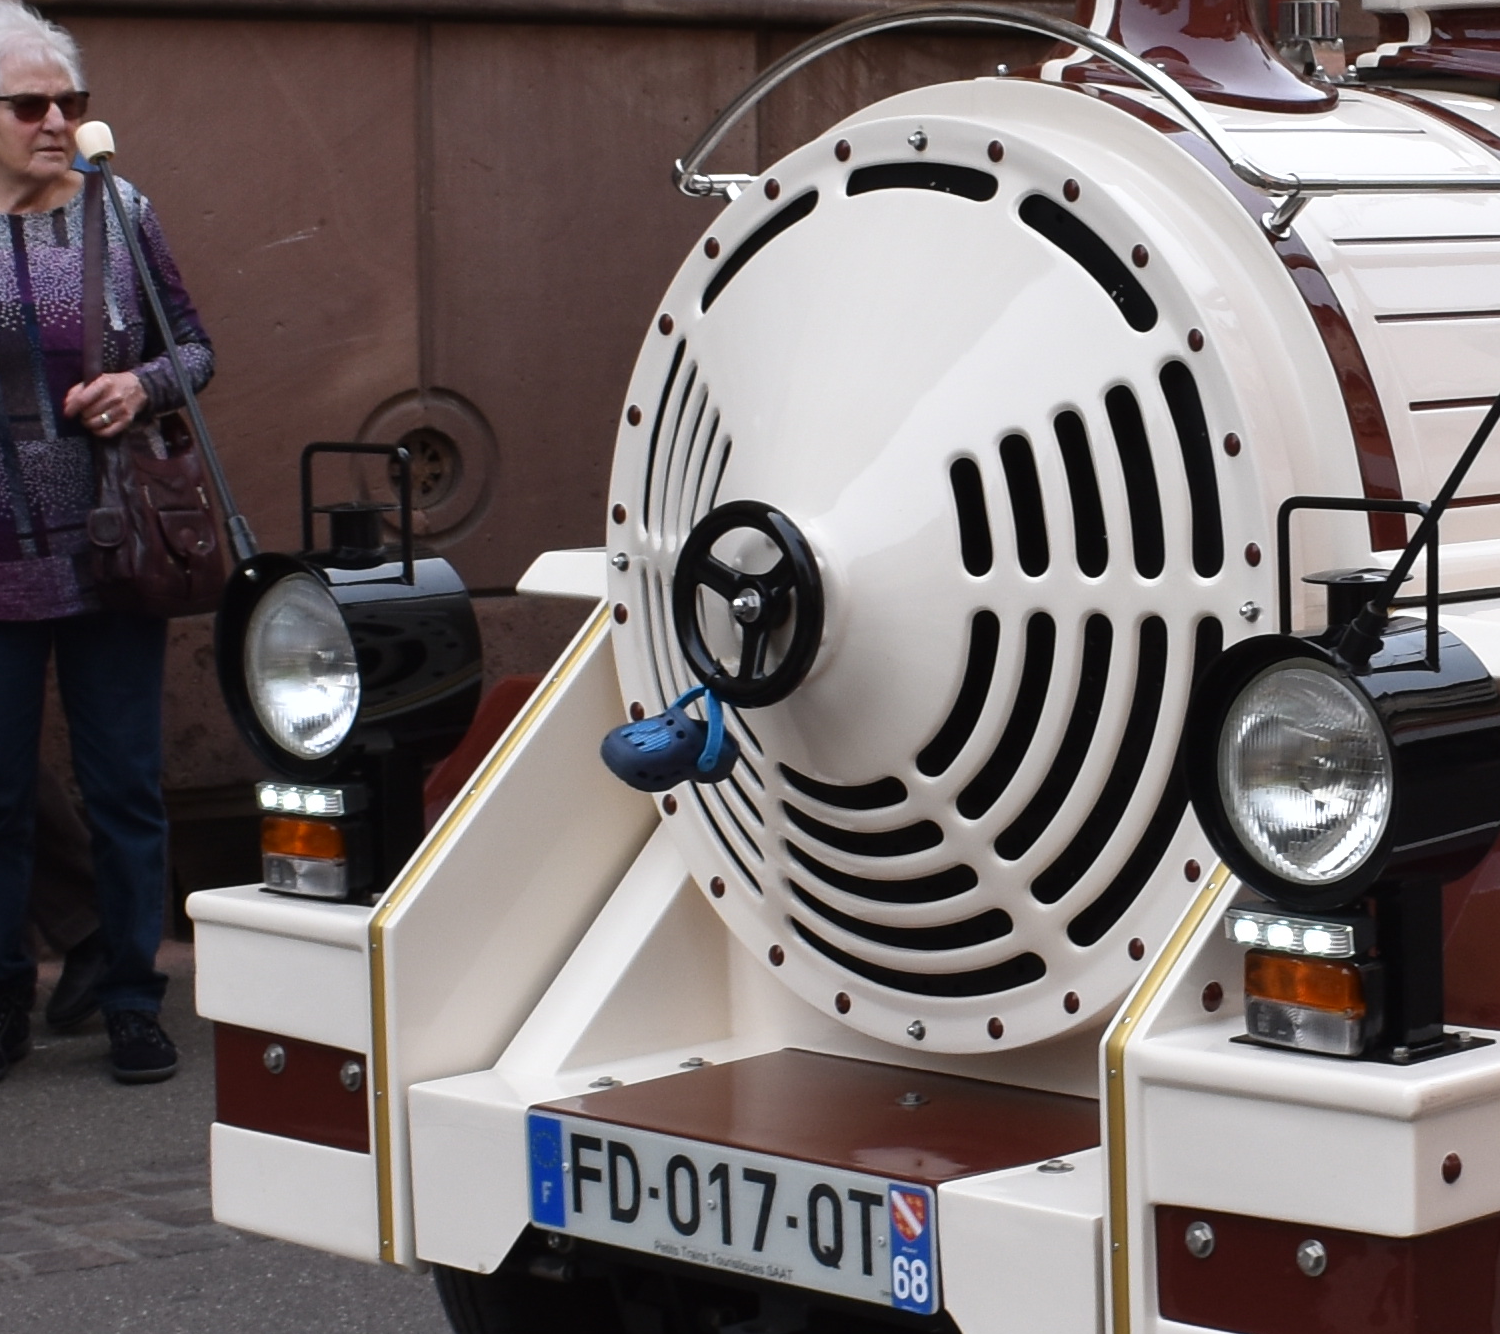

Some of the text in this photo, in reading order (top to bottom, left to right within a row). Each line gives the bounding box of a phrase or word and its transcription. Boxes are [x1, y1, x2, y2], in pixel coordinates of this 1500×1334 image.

[542, 1181, 552, 1203] F
[570, 1133, 884, 1276] FD-017-QT
[681, 1246, 709, 1263] Trains
[893, 1255, 929, 1303] 68
